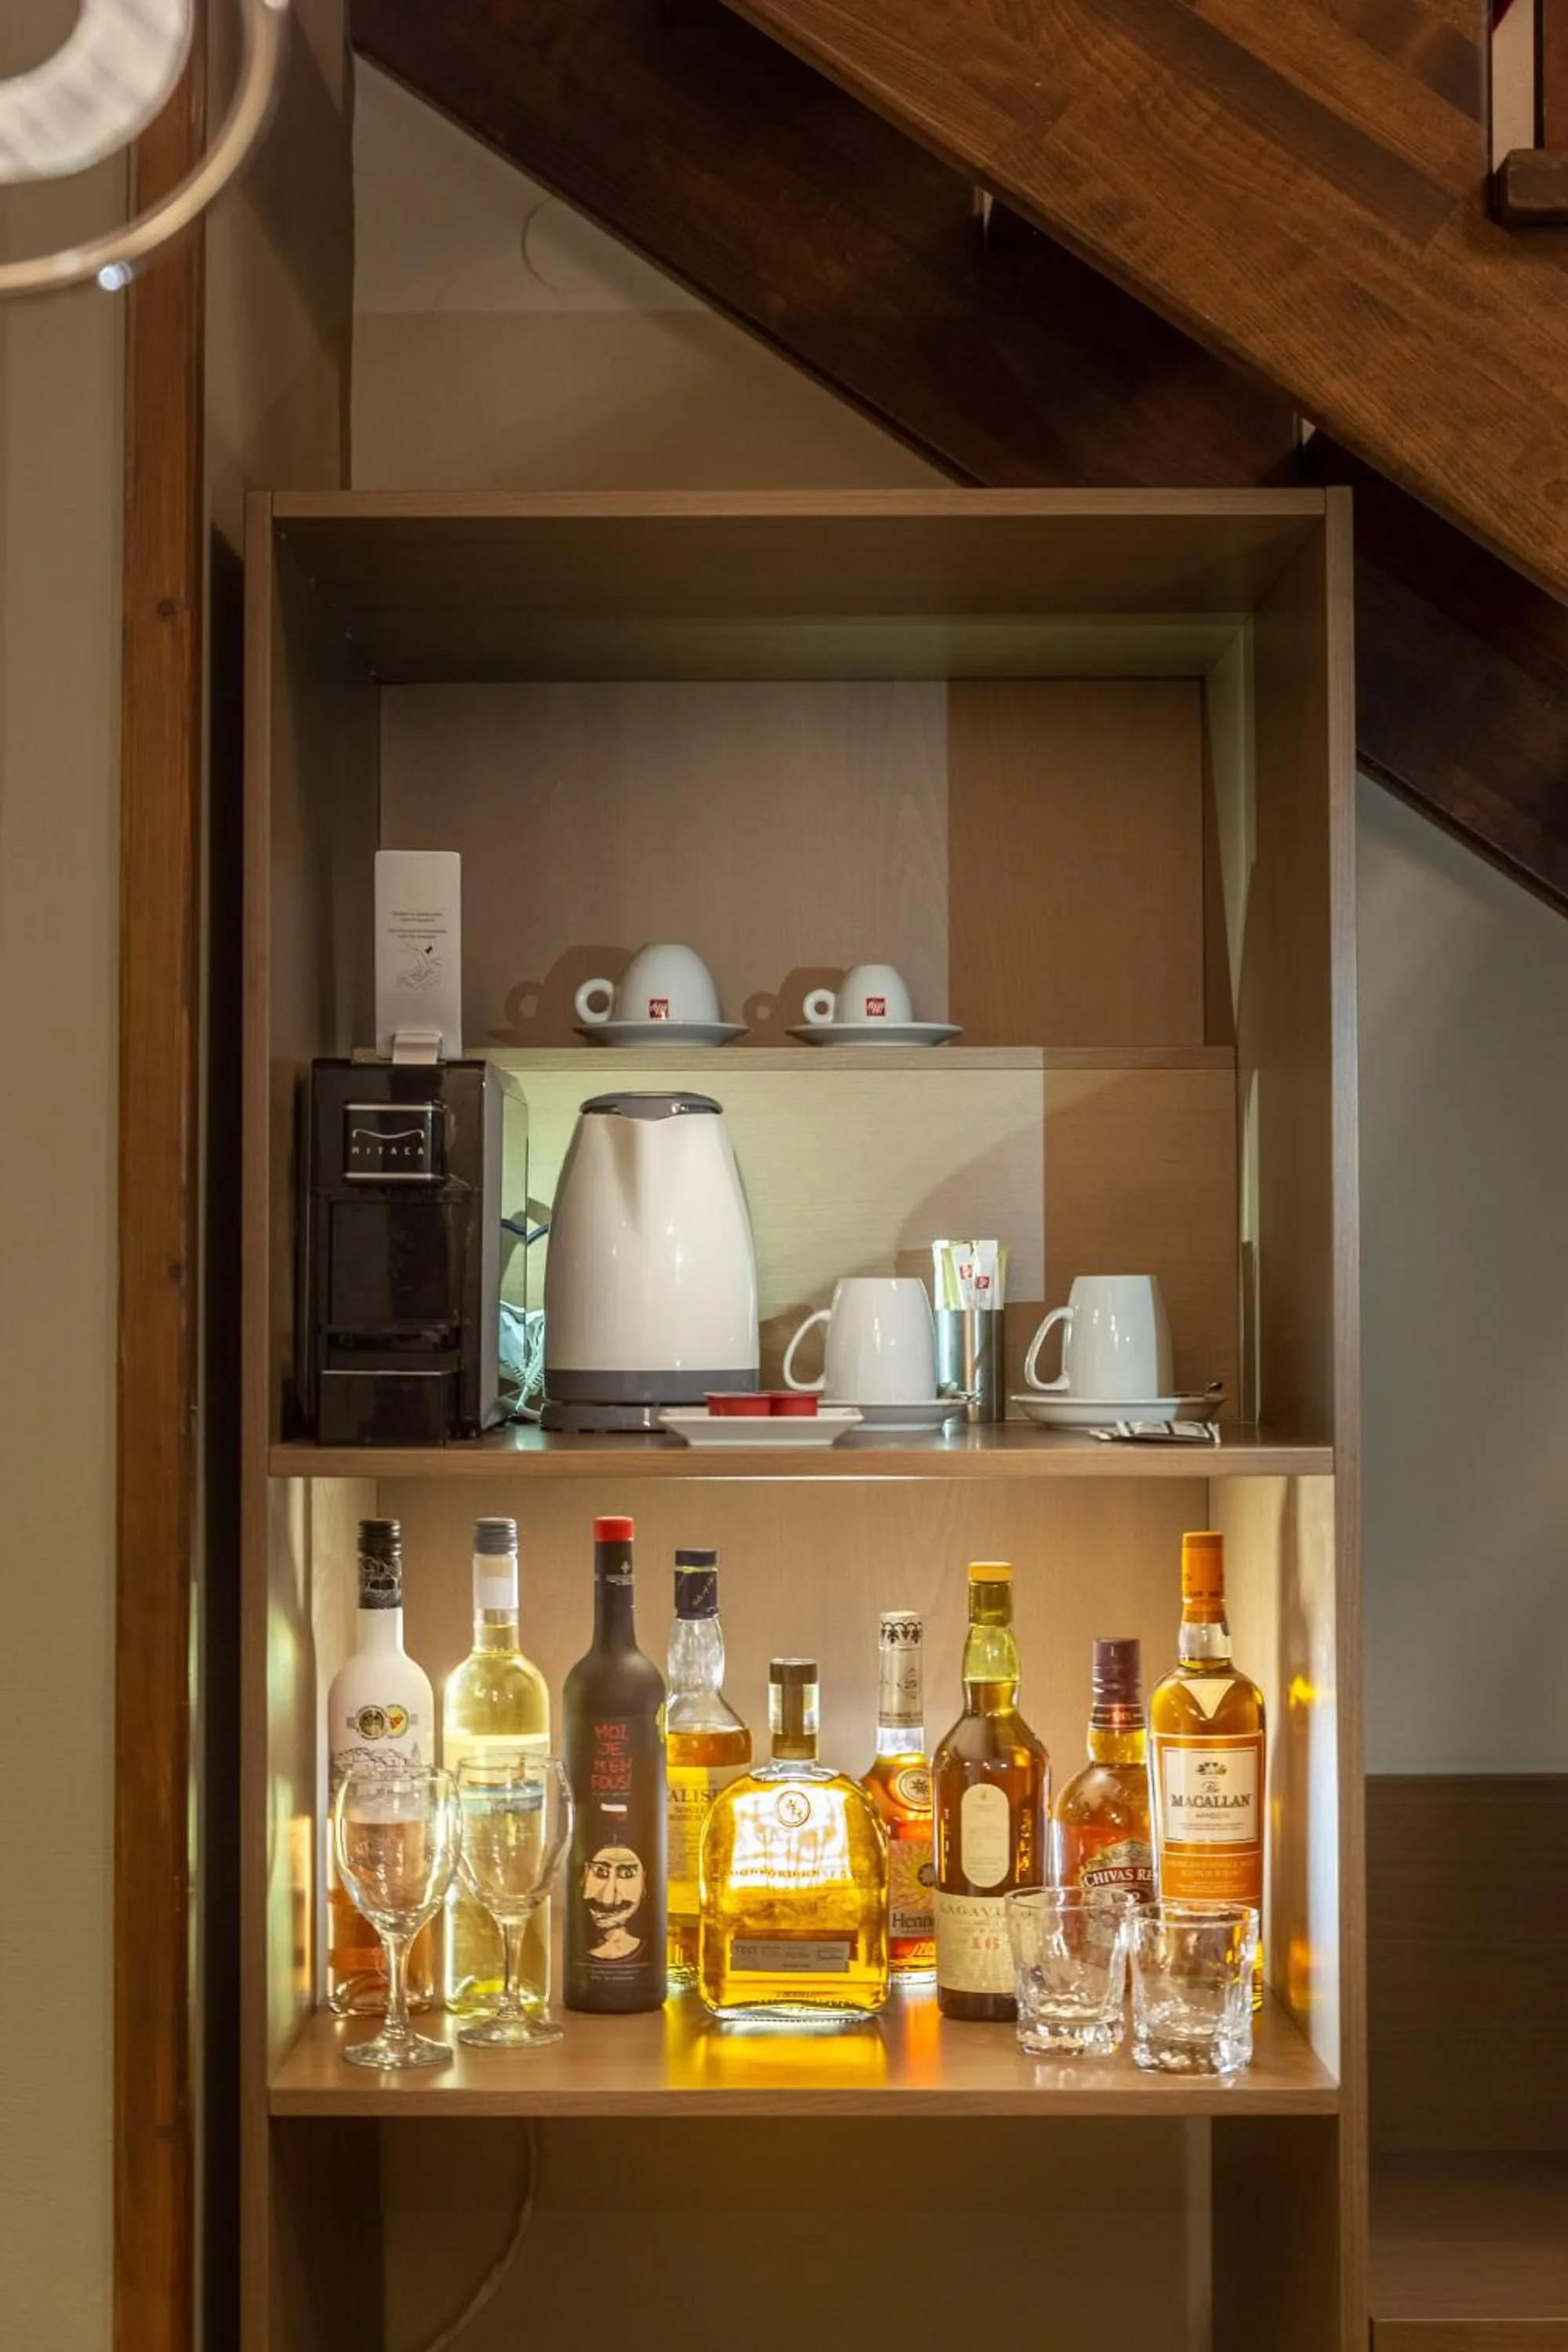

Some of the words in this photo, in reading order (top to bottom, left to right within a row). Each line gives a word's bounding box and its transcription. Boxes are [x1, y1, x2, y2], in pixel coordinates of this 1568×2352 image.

[352, 1146, 424, 1155] MITACA
[593, 1724, 628, 1740] MOI
[598, 1741, 626, 1757] JE
[1171, 1793, 1252, 1808] MACALLAN
[1083, 1868, 1134, 1887] CHIVAS
[892, 1913, 935, 1928] Henn
[971, 1936, 1001, 1951] 16
